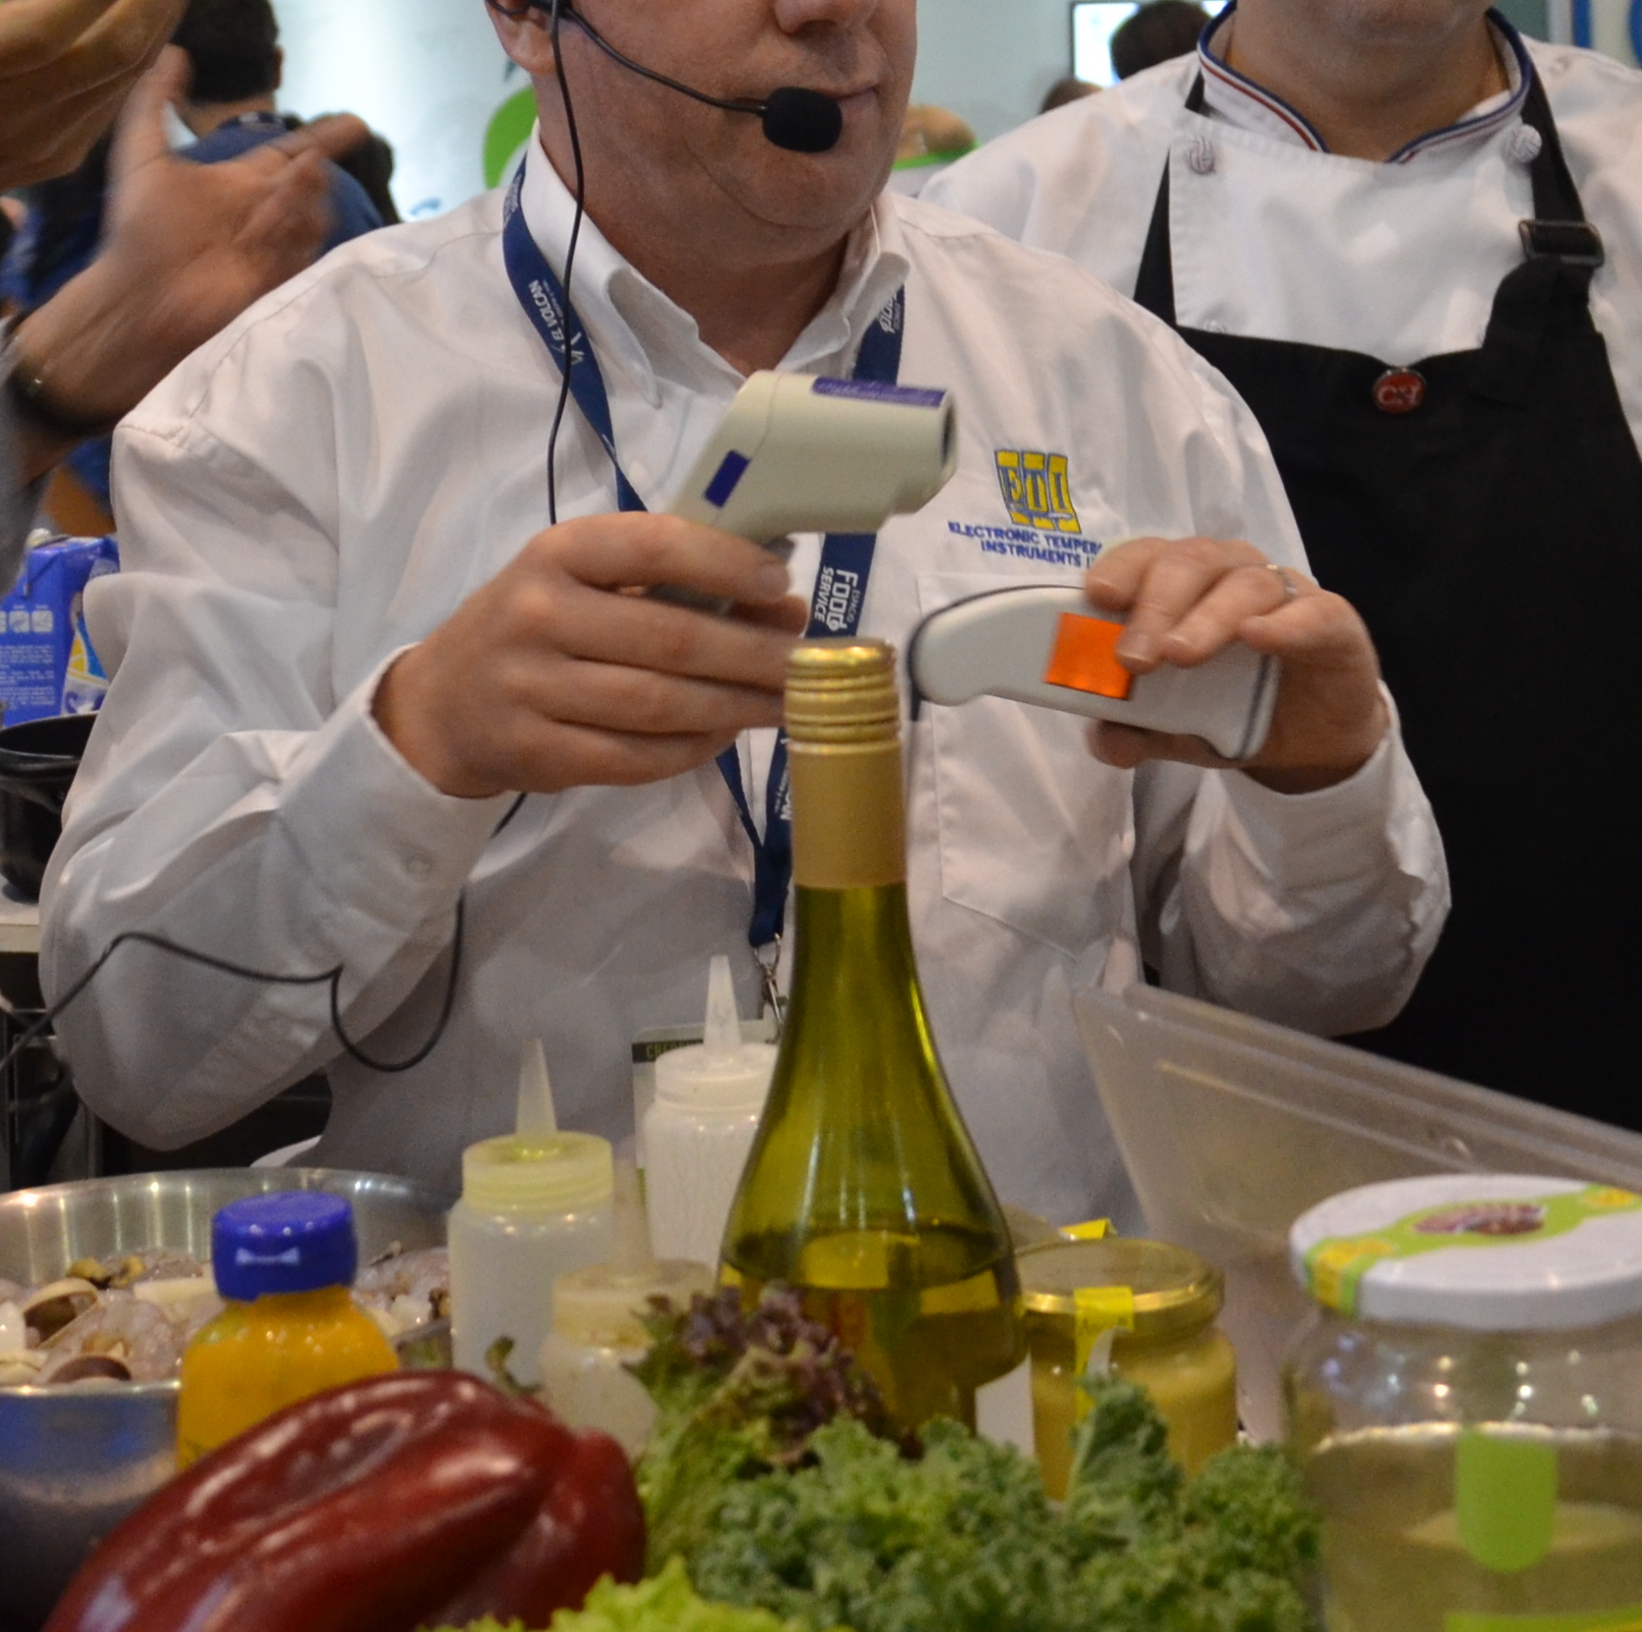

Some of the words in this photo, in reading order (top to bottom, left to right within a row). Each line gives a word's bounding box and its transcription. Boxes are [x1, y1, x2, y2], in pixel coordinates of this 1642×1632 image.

[528, 278, 558, 329] VOLCAN
[947, 520, 1041, 546] ELECTRONIC
[981, 539, 1082, 569] INSTRUMENTS
[814, 564, 835, 625] SERVICE
